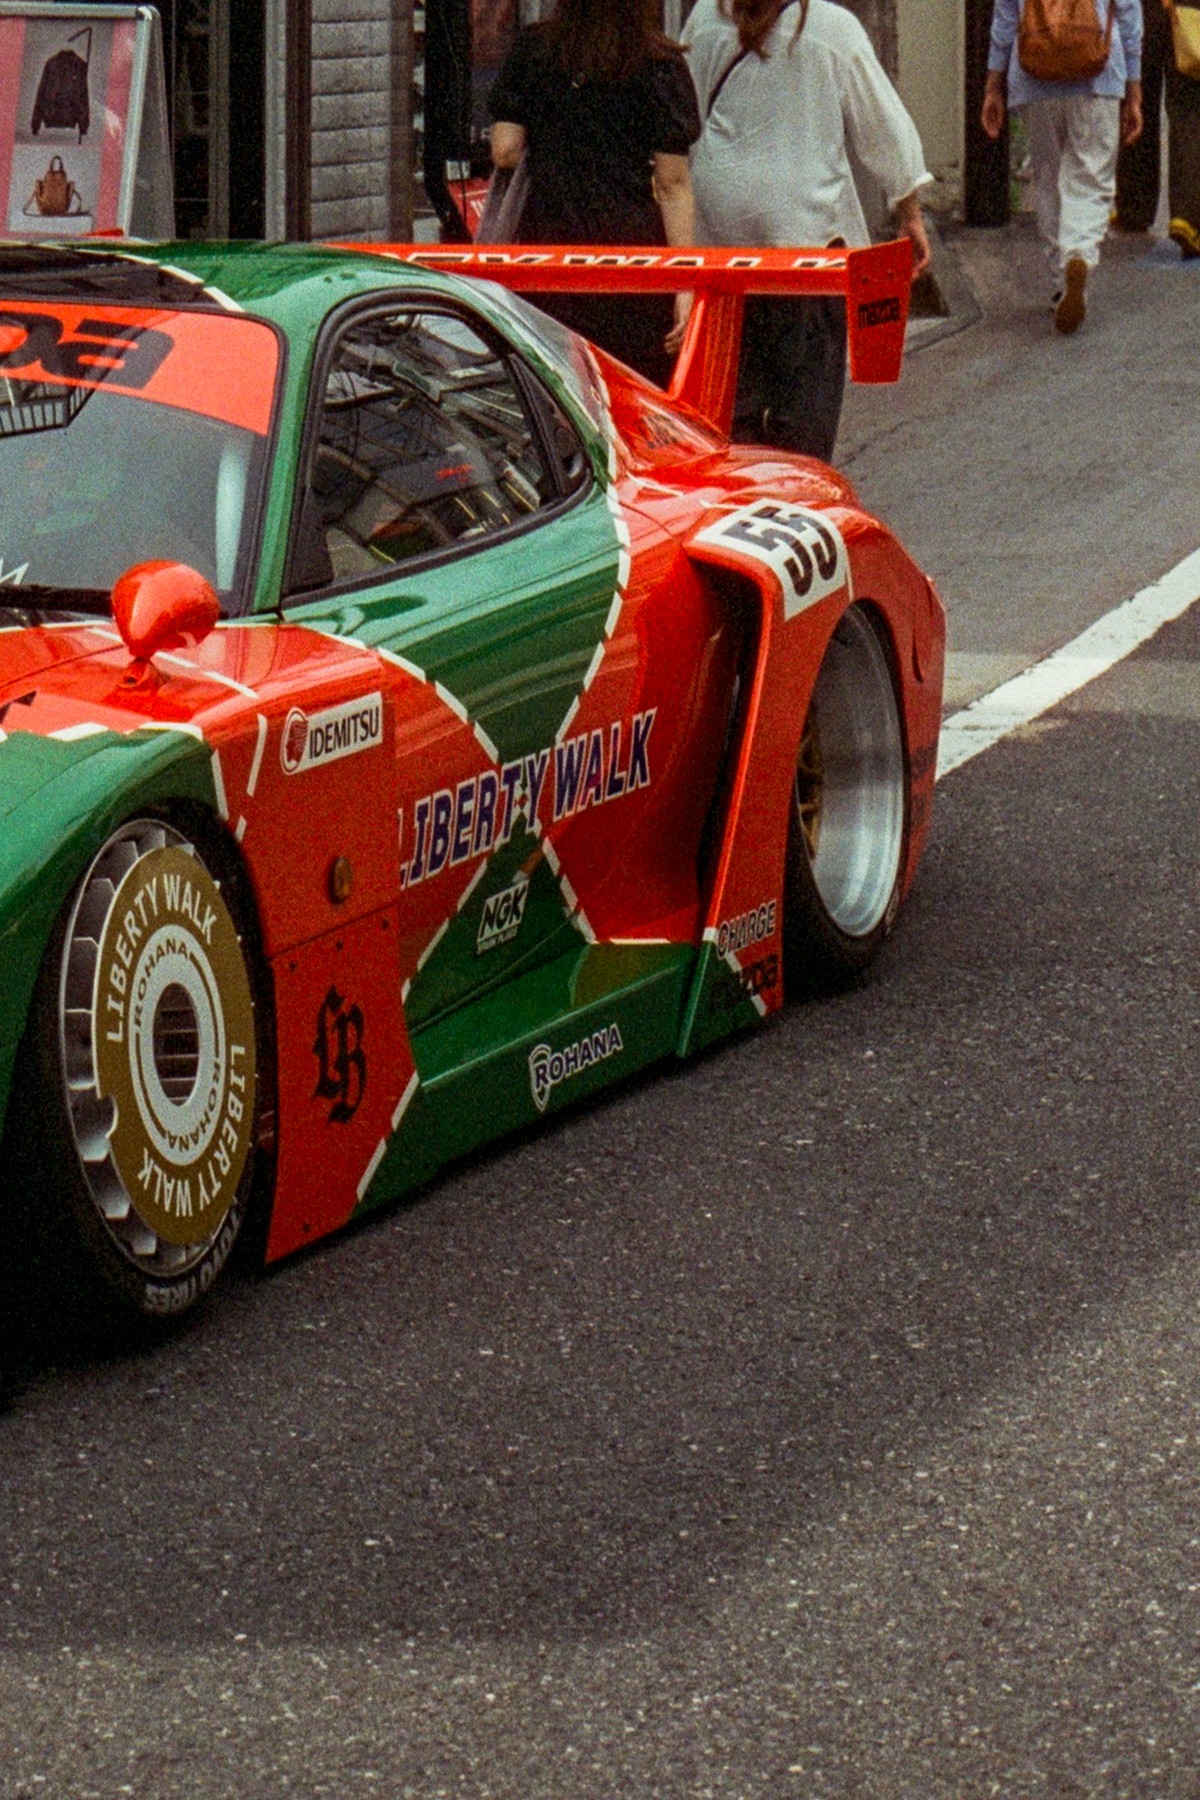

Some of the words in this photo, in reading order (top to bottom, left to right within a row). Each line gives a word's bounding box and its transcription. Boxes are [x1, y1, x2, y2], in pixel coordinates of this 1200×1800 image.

[721, 505, 838, 598] 55
[308, 706, 380, 760] IDEMITSU
[553, 707, 658, 822] WALK
[106, 876, 158, 1042] LIBERTY
[163, 873, 217, 946] WALK
[480, 884, 529, 938] NGK
[716, 899, 777, 959] CHARGE
[133, 938, 192, 1032] ROHANA
[532, 1022, 624, 1091] ROHANA
[166, 1056, 222, 1153] ROHANA
[199, 1044, 246, 1211] LIBERTY
[136, 1147, 194, 1218] WALK
